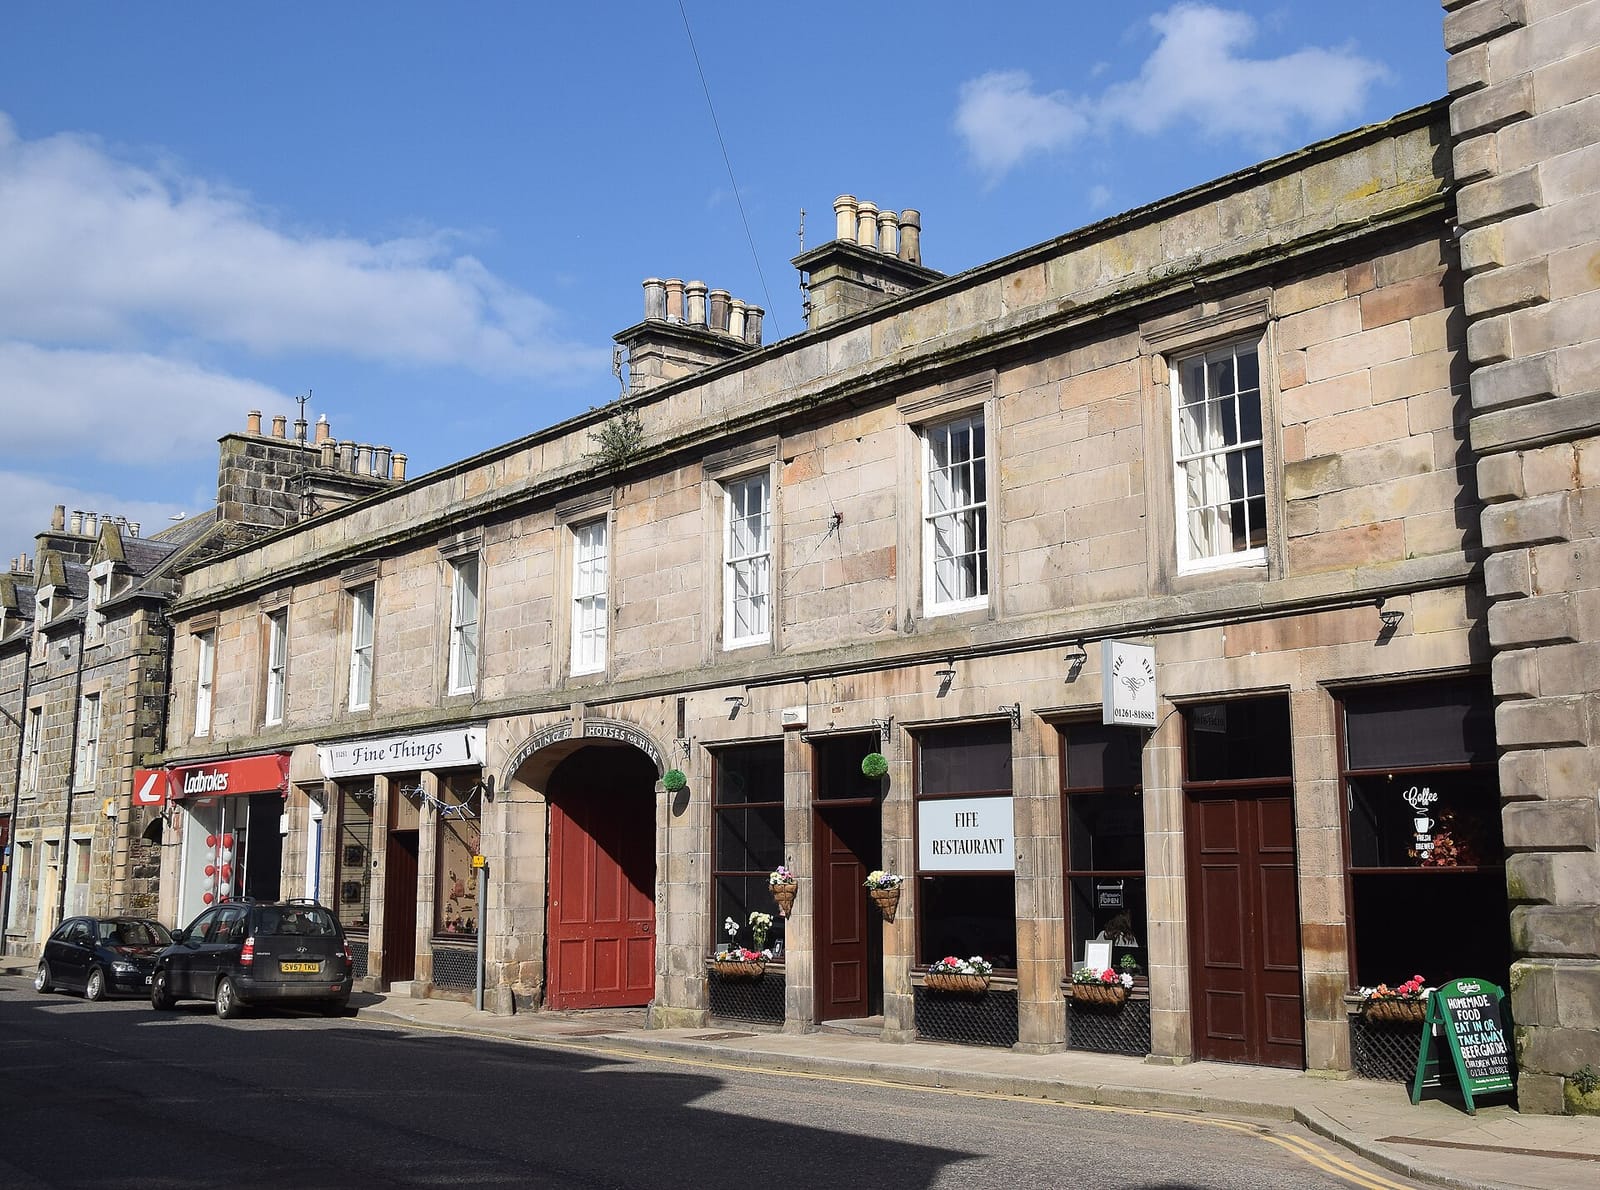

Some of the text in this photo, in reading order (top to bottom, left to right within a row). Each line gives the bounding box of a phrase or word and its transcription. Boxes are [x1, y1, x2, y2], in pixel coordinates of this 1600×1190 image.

[1112, 655, 1155, 683] THE FIFE
[352, 740, 443, 766] Fine Things
[508, 732, 562, 775] STABLING
[588, 727, 625, 740] HORSES
[639, 738, 659, 766] HIRE
[183, 769, 229, 793] Ladbrokes
[1403, 786, 1438, 806] Coffee
[955, 812, 979, 827] FIFE
[932, 838, 1005, 855] RESTAURANT
[1447, 994, 1491, 1010] HOMEMADE
[1457, 1008, 1480, 1021] FOOD
[1454, 1019, 1497, 1034] EAT IN OR
[1457, 1029, 1505, 1047] TAKEAWAY
